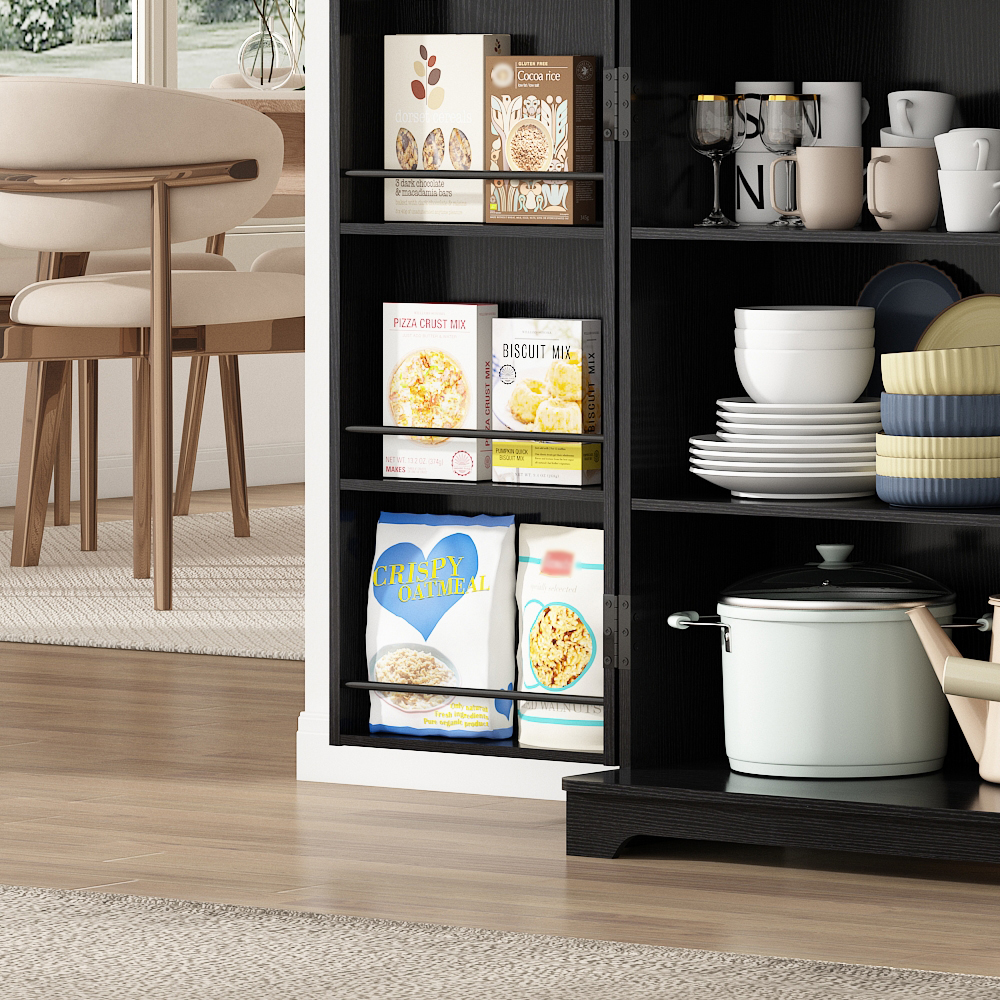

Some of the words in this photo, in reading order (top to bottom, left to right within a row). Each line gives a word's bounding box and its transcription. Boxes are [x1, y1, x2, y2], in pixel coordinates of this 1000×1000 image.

[518, 70, 543, 81] Cocoa
[545, 70, 561, 81] rice
[395, 109, 430, 123] dorset
[432, 110, 472, 123] cereals
[401, 178, 415, 187] dark
[416, 179, 445, 188] chocolate
[736, 164, 765, 209] N
[395, 188, 400, 197] &
[402, 188, 437, 197] macadamia
[439, 189, 453, 197] bars
[393, 317, 418, 328] PIZZA
[419, 318, 448, 329] CRUST
[450, 319, 466, 330] MIX
[502, 343, 546, 359] BISCUIT
[552, 345, 571, 360] MIX
[385, 465, 406, 473] MAKES
[372, 555, 465, 588] CRISPY
[398, 574, 491, 603] OATMEAL
[449, 702, 464, 711] Only
[540, 701, 602, 714] WALNUTS
[434, 709, 453, 719] Fresh
[423, 717, 437, 725] Pure
[439, 718, 463, 728] organic
[464, 719, 489, 728] product
